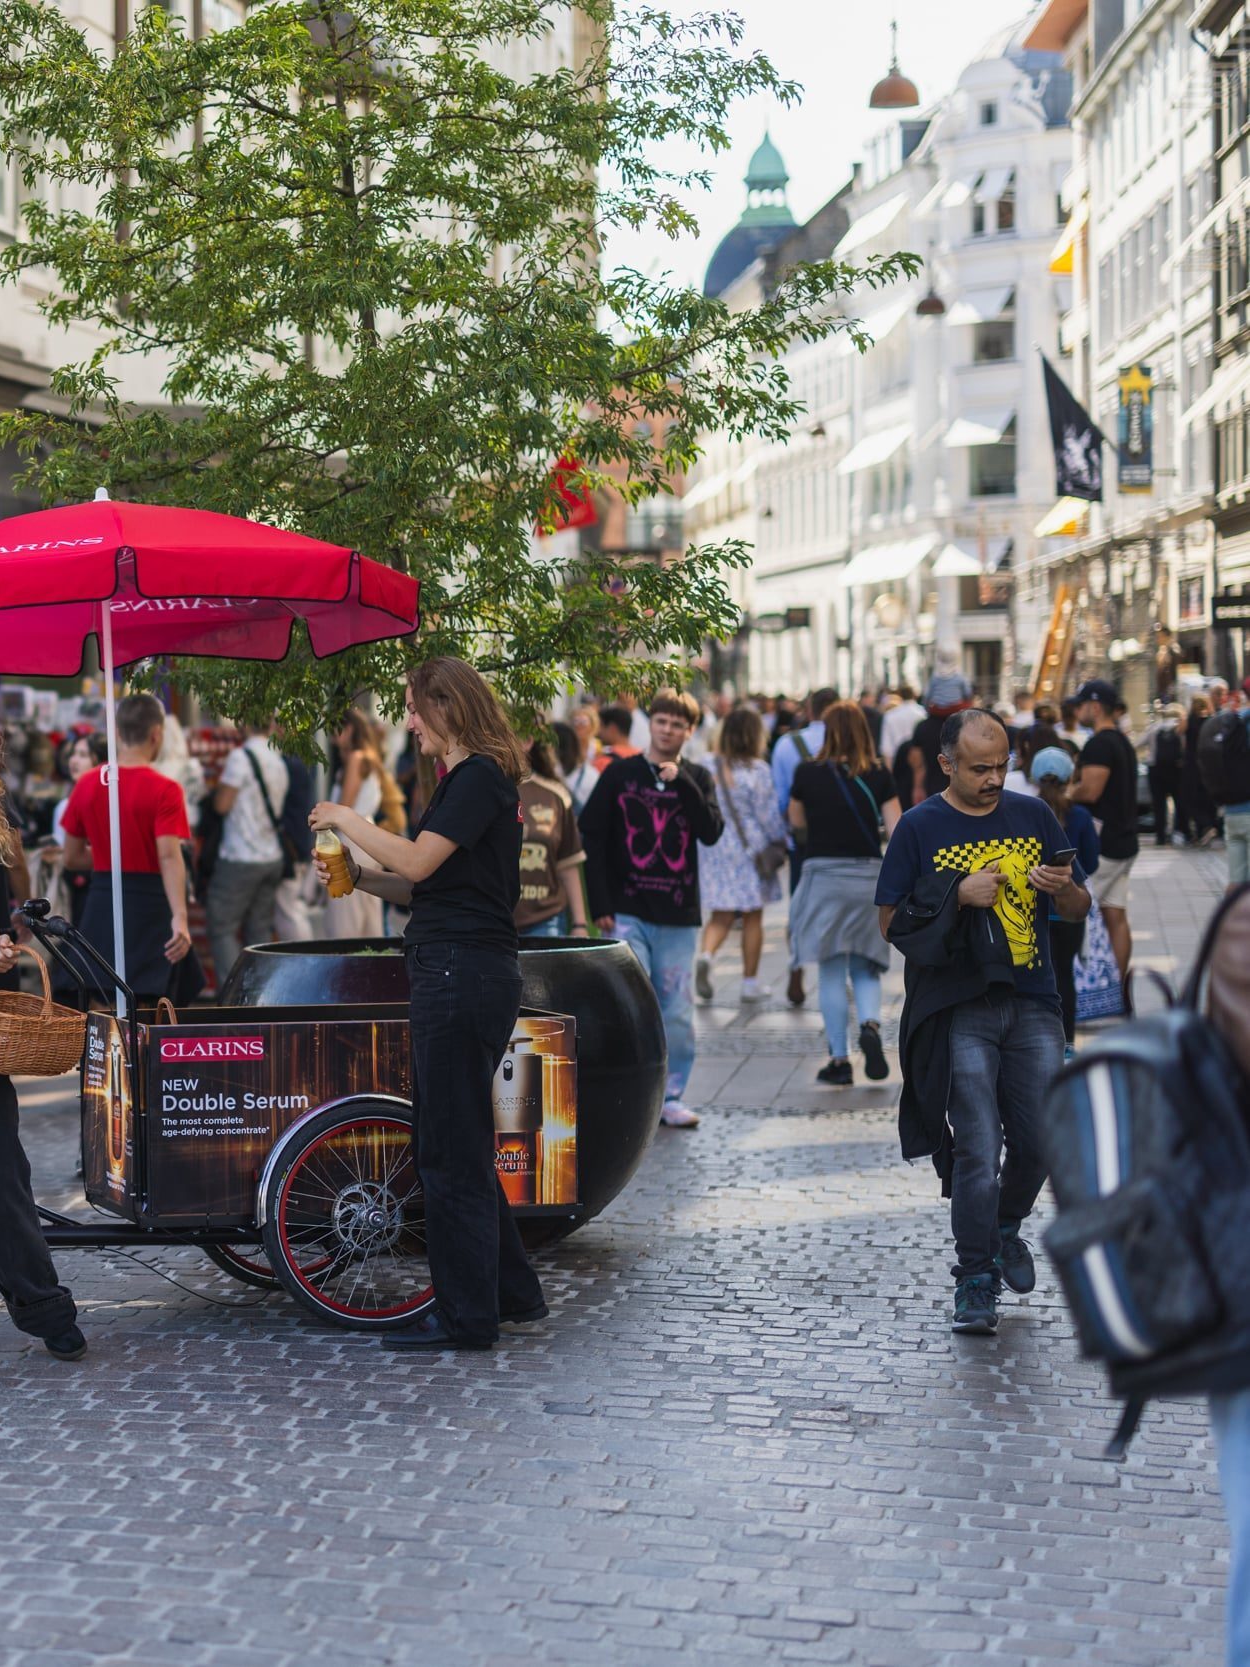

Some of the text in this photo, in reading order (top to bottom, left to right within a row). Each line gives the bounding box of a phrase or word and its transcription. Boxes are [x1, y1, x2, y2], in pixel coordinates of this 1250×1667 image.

[161, 1041, 264, 1057] CLARINS
[162, 1079, 198, 1091] NEW
[162, 1093, 309, 1111] Double Serum
[162, 1118, 177, 1126] The
[203, 1116, 244, 1127] complete
[162, 1128, 213, 1138] age-defying
